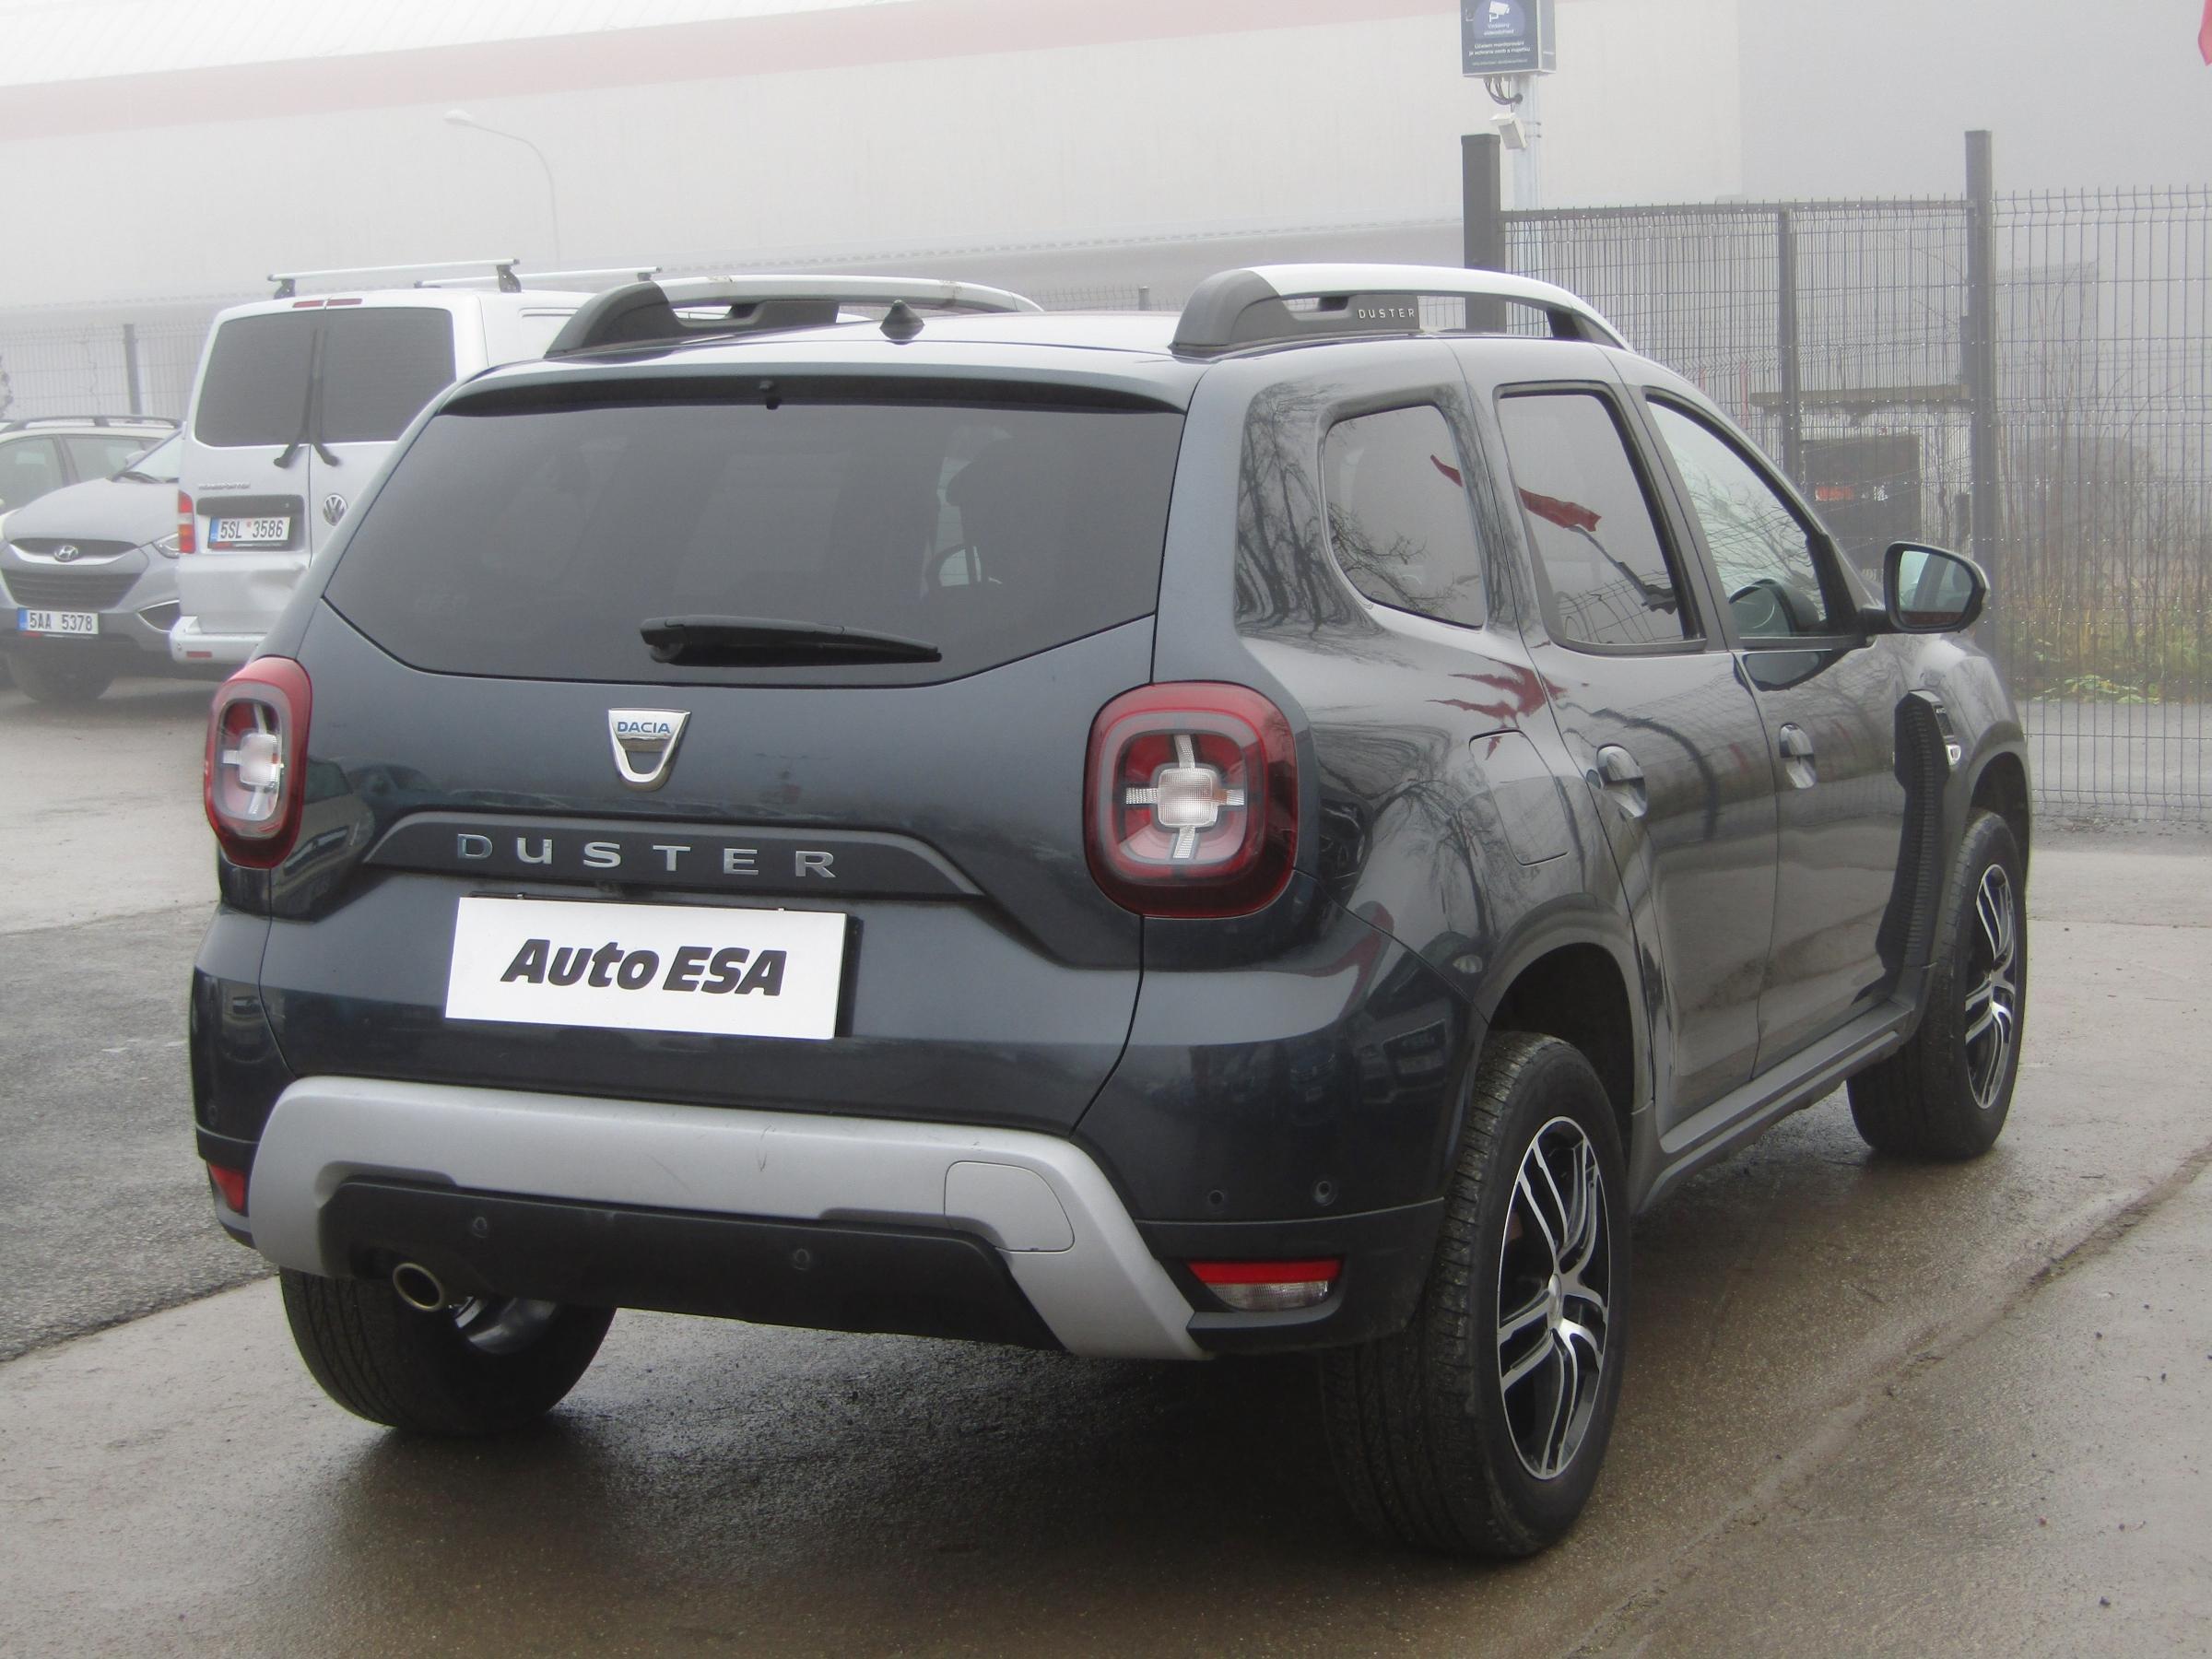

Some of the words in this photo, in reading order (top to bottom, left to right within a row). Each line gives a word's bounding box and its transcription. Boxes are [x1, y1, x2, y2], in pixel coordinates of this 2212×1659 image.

[1358, 308, 1415, 319] DUSTER
[220, 521, 241, 538] 5SL
[253, 520, 283, 538] 3586
[29, 612, 52, 629] 5AA
[61, 614, 92, 631] 5378
[617, 721, 671, 734] DACIA
[457, 833, 836, 878] DUSTER
[500, 938, 660, 991] Auto
[662, 946, 787, 996] ESA
